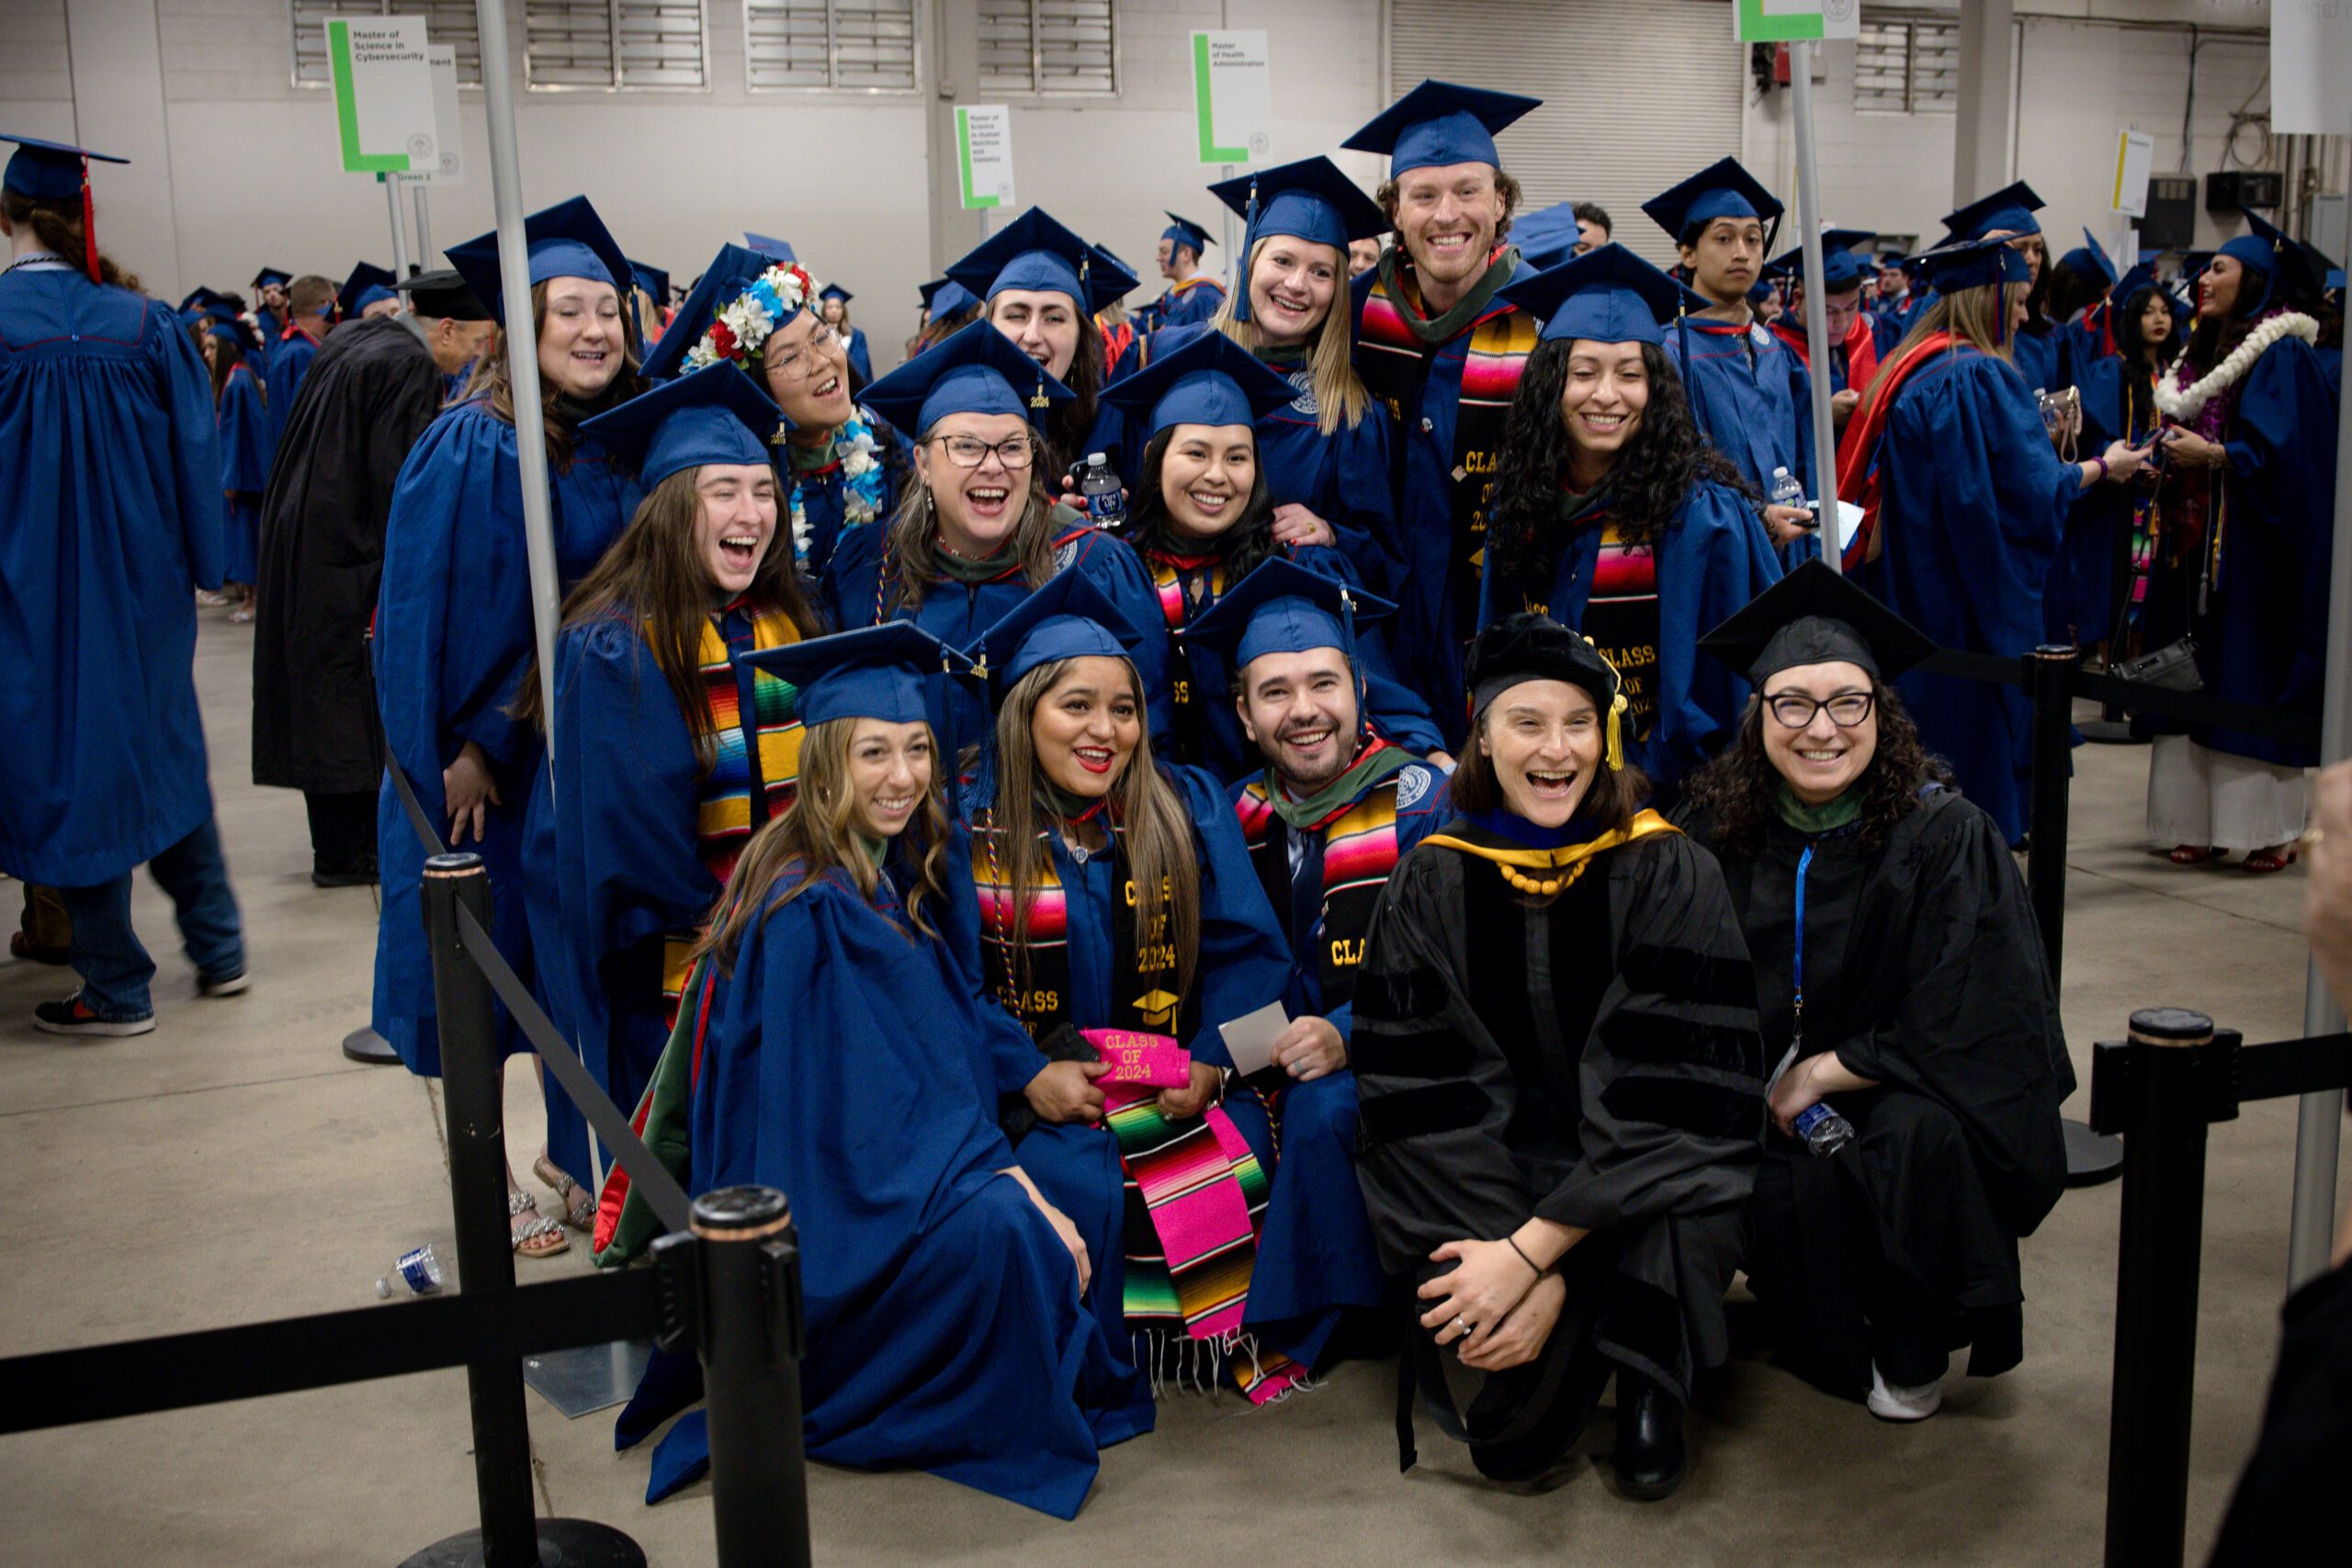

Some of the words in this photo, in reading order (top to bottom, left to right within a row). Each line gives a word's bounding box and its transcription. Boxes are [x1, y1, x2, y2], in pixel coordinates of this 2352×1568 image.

[354, 30, 386, 39] Master
[356, 52, 424, 62] Cybersecurity
[398, 173, 424, 181] Green
[1030, 396, 1050, 408] 2024
[1465, 450, 1498, 474] CLA
[1138, 943, 1176, 973] 2024
[1331, 938, 1365, 966] CLA
[1105, 1034, 1158, 1050] CLASS
[1123, 1049, 1142, 1064] OF
[1115, 1063, 1152, 1081] 2024
